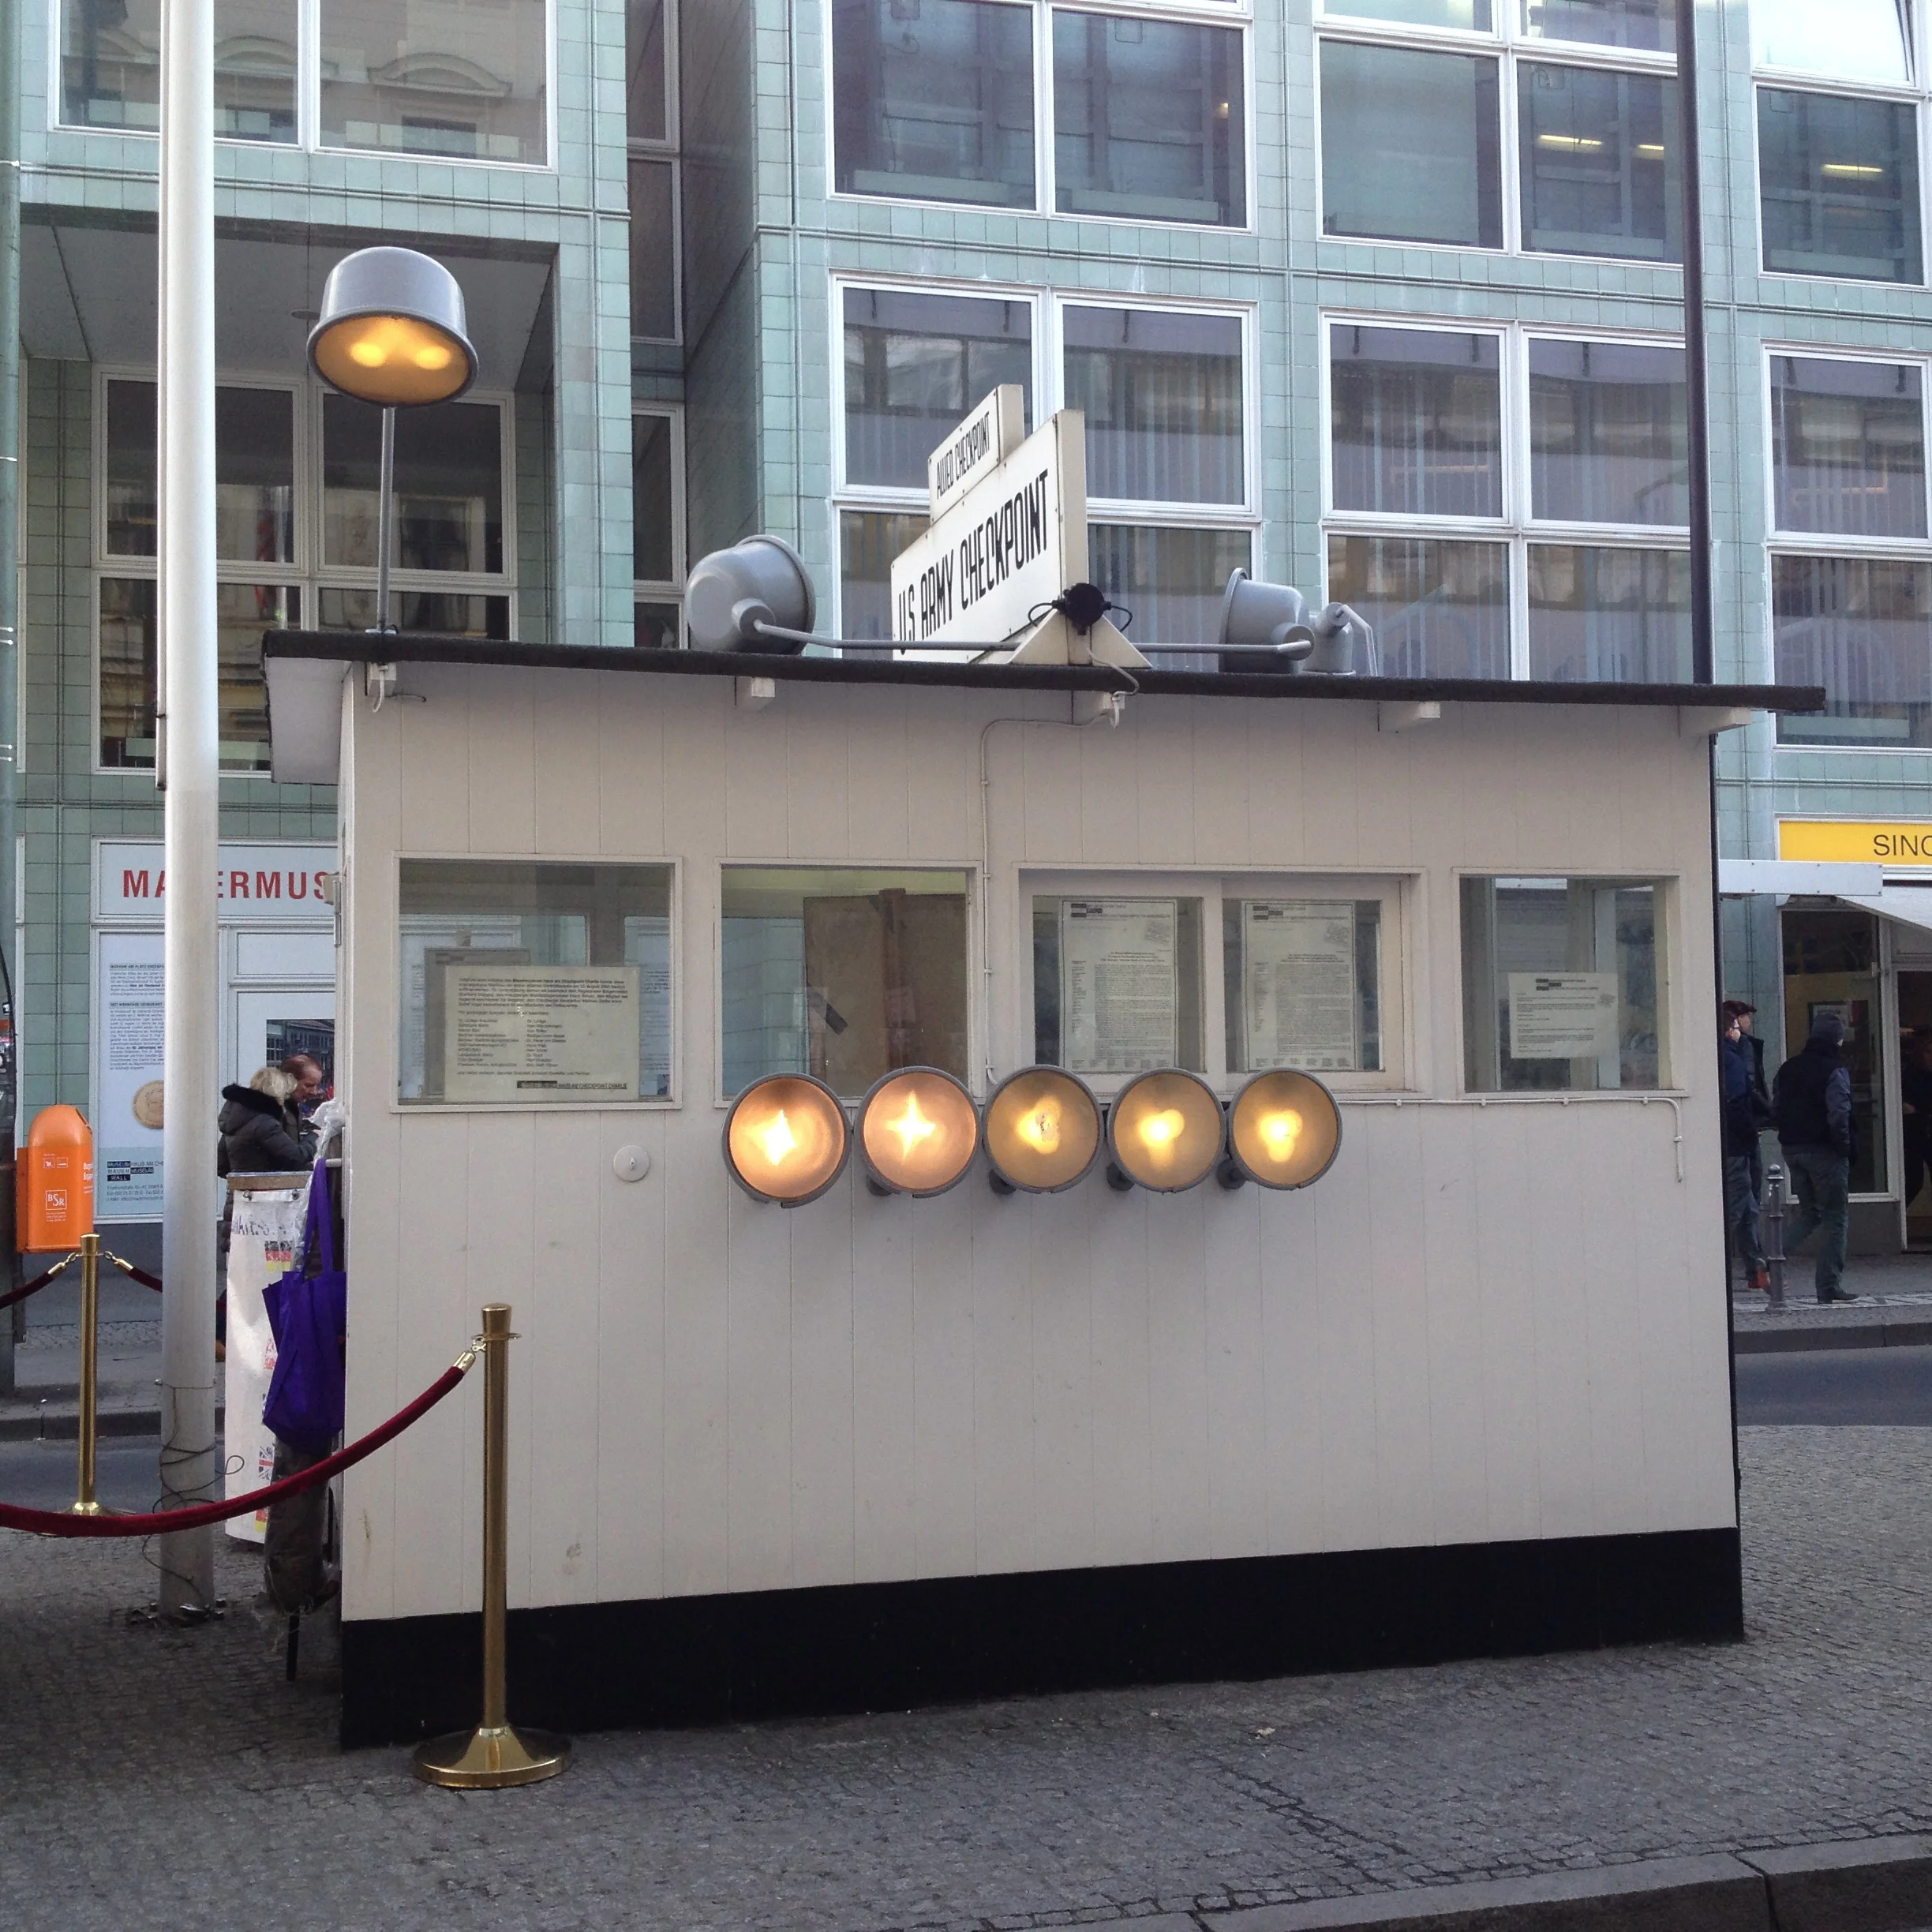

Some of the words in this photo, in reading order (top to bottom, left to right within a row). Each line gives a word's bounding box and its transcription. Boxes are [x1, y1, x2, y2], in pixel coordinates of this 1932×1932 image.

[937, 450, 953, 500] ALLIED
[956, 411, 990, 481] CHECKPOINT
[921, 549, 954, 640] ARMY
[960, 468, 1048, 610] CHECKPOINT
[123, 870, 328, 899] MRMUS
[47, 1193, 65, 1206] BSR
